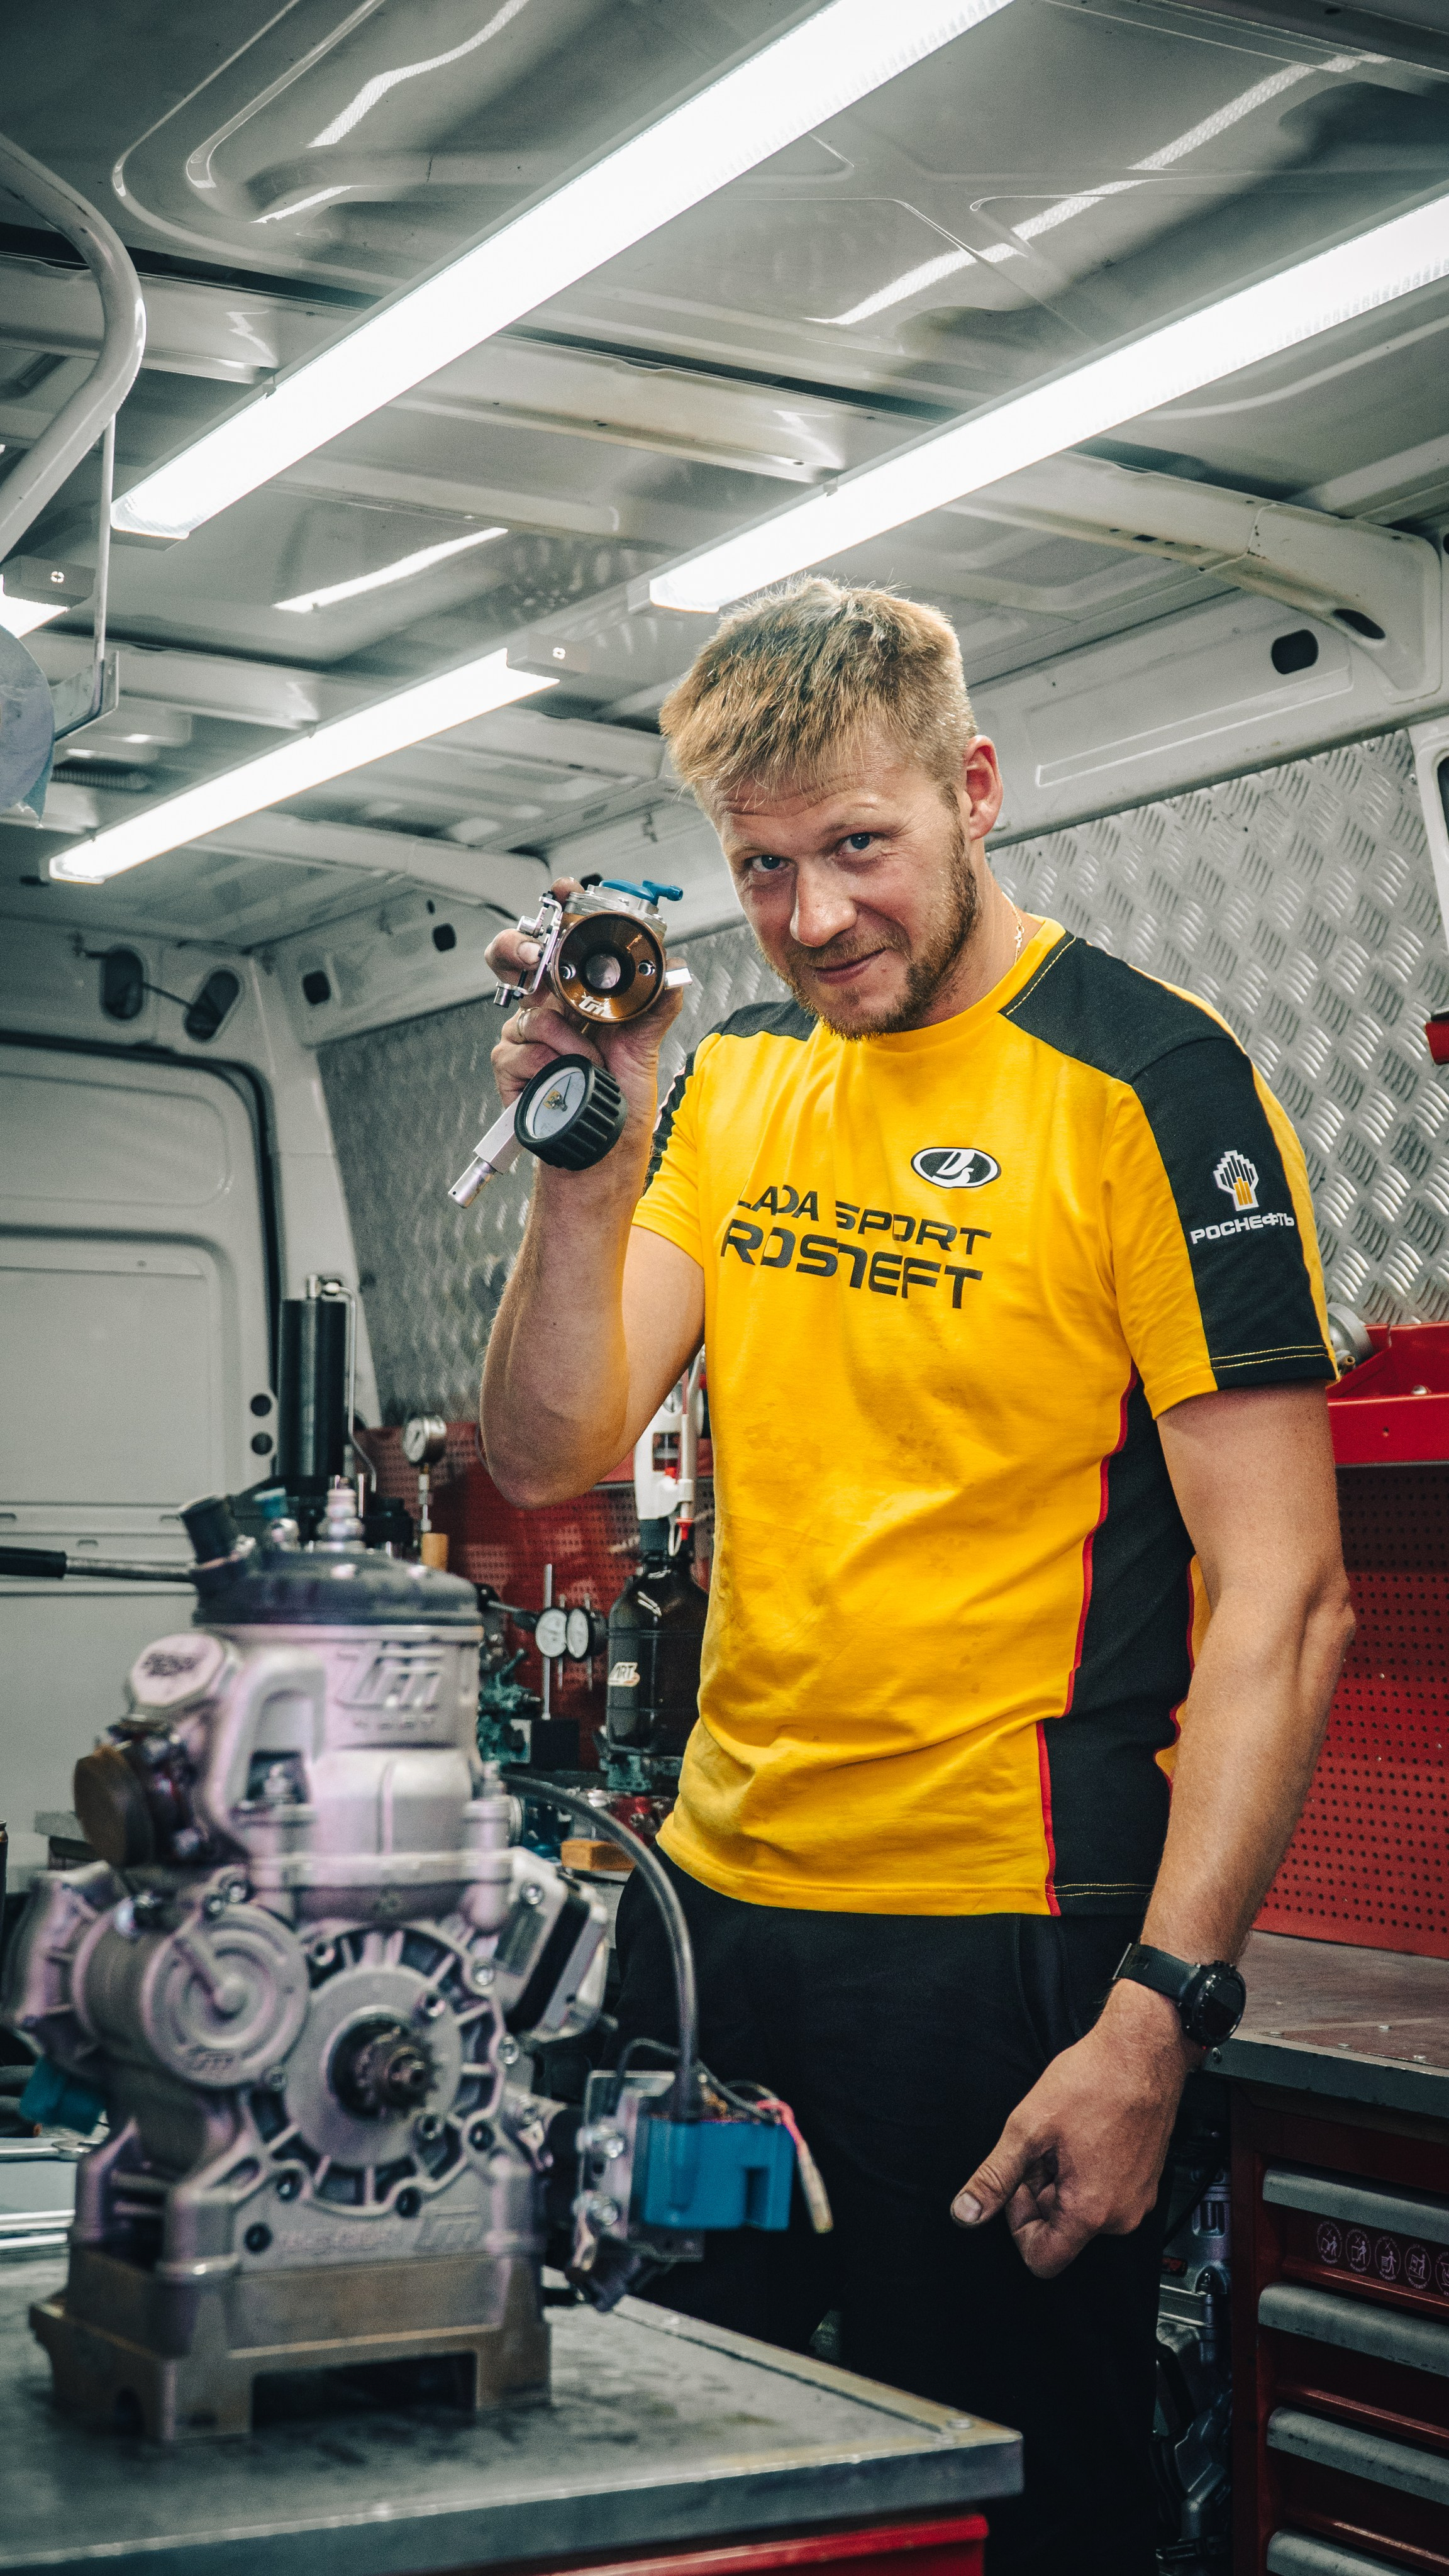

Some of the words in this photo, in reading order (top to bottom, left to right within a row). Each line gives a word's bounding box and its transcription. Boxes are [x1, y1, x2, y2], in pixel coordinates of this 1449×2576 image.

[835, 1200, 992, 1255] SPORT
[1190, 1213, 1295, 1244] РОСНЕФТЬ
[720, 1218, 984, 1309] ROSNEFT
